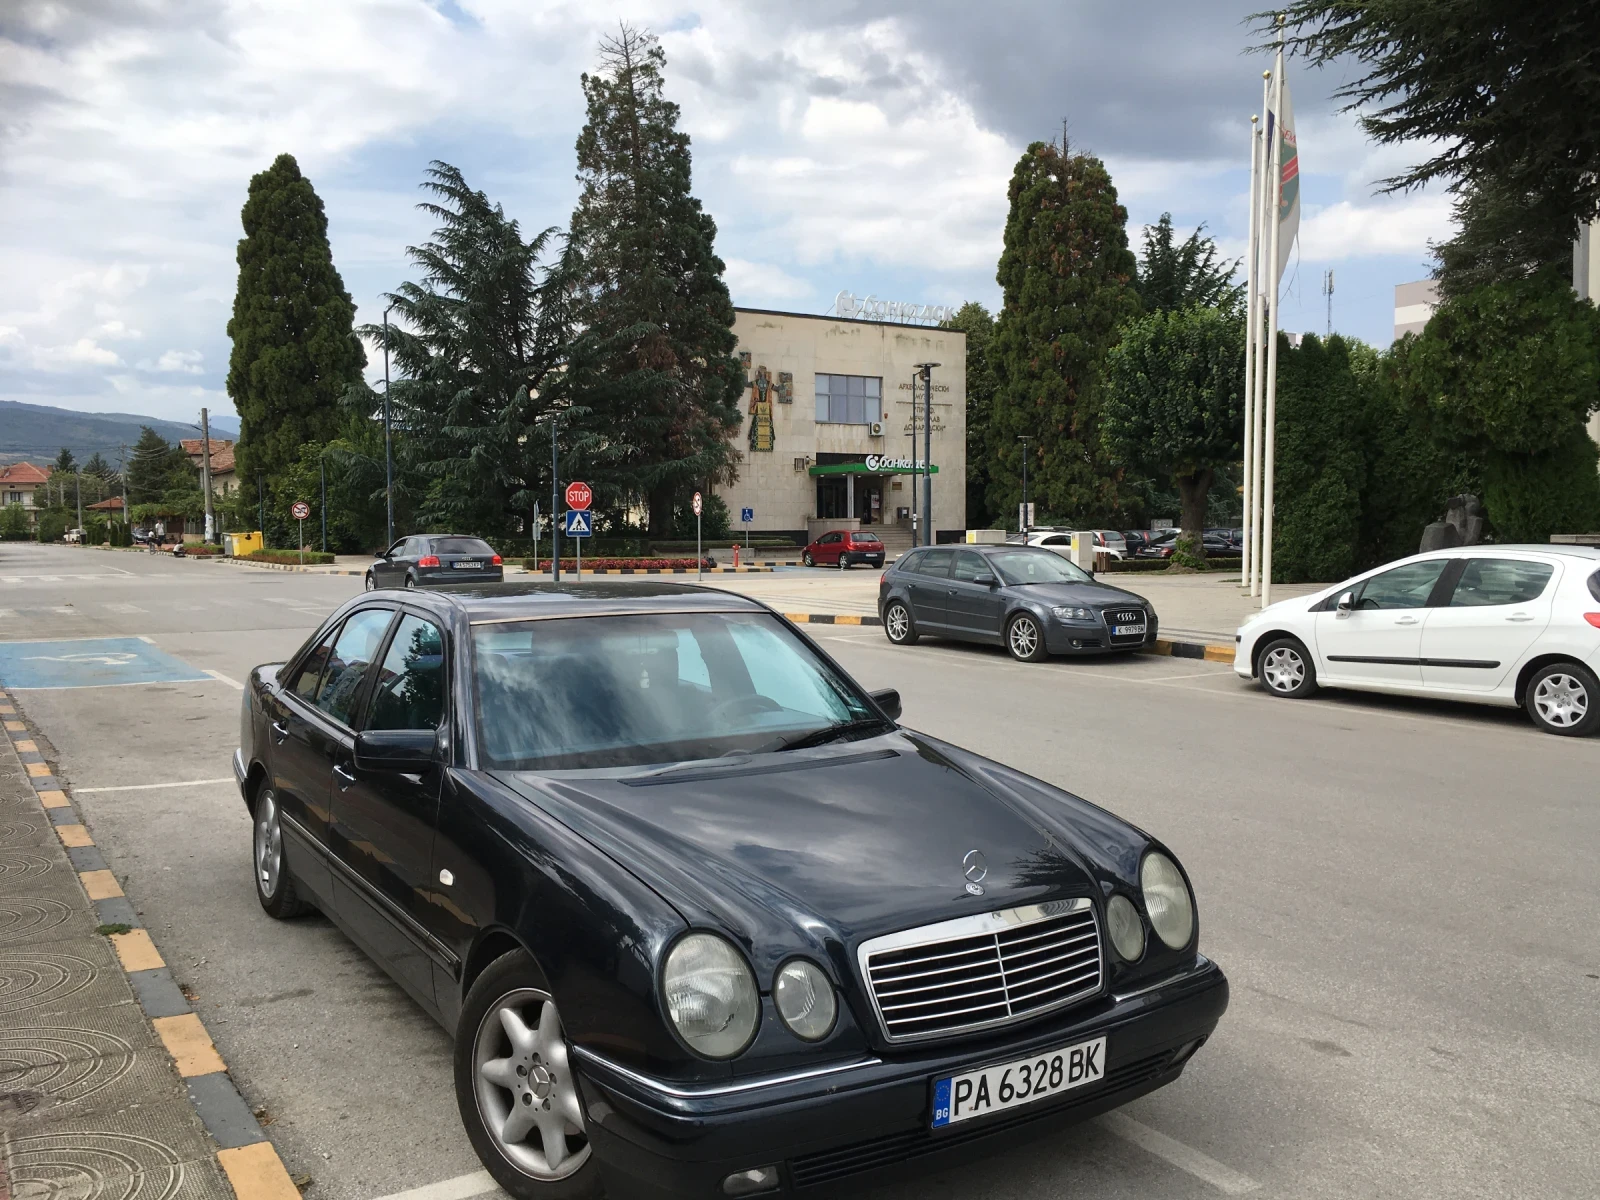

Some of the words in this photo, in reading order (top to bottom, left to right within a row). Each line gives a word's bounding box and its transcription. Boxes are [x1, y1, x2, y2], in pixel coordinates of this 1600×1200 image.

[880, 455, 911, 469] банка
[568, 490, 590, 502] STOP
[953, 1074, 992, 1116] PA
[999, 1055, 1063, 1103] 6328
[1068, 1043, 1101, 1084] BK
[935, 1107, 949, 1121] BG
